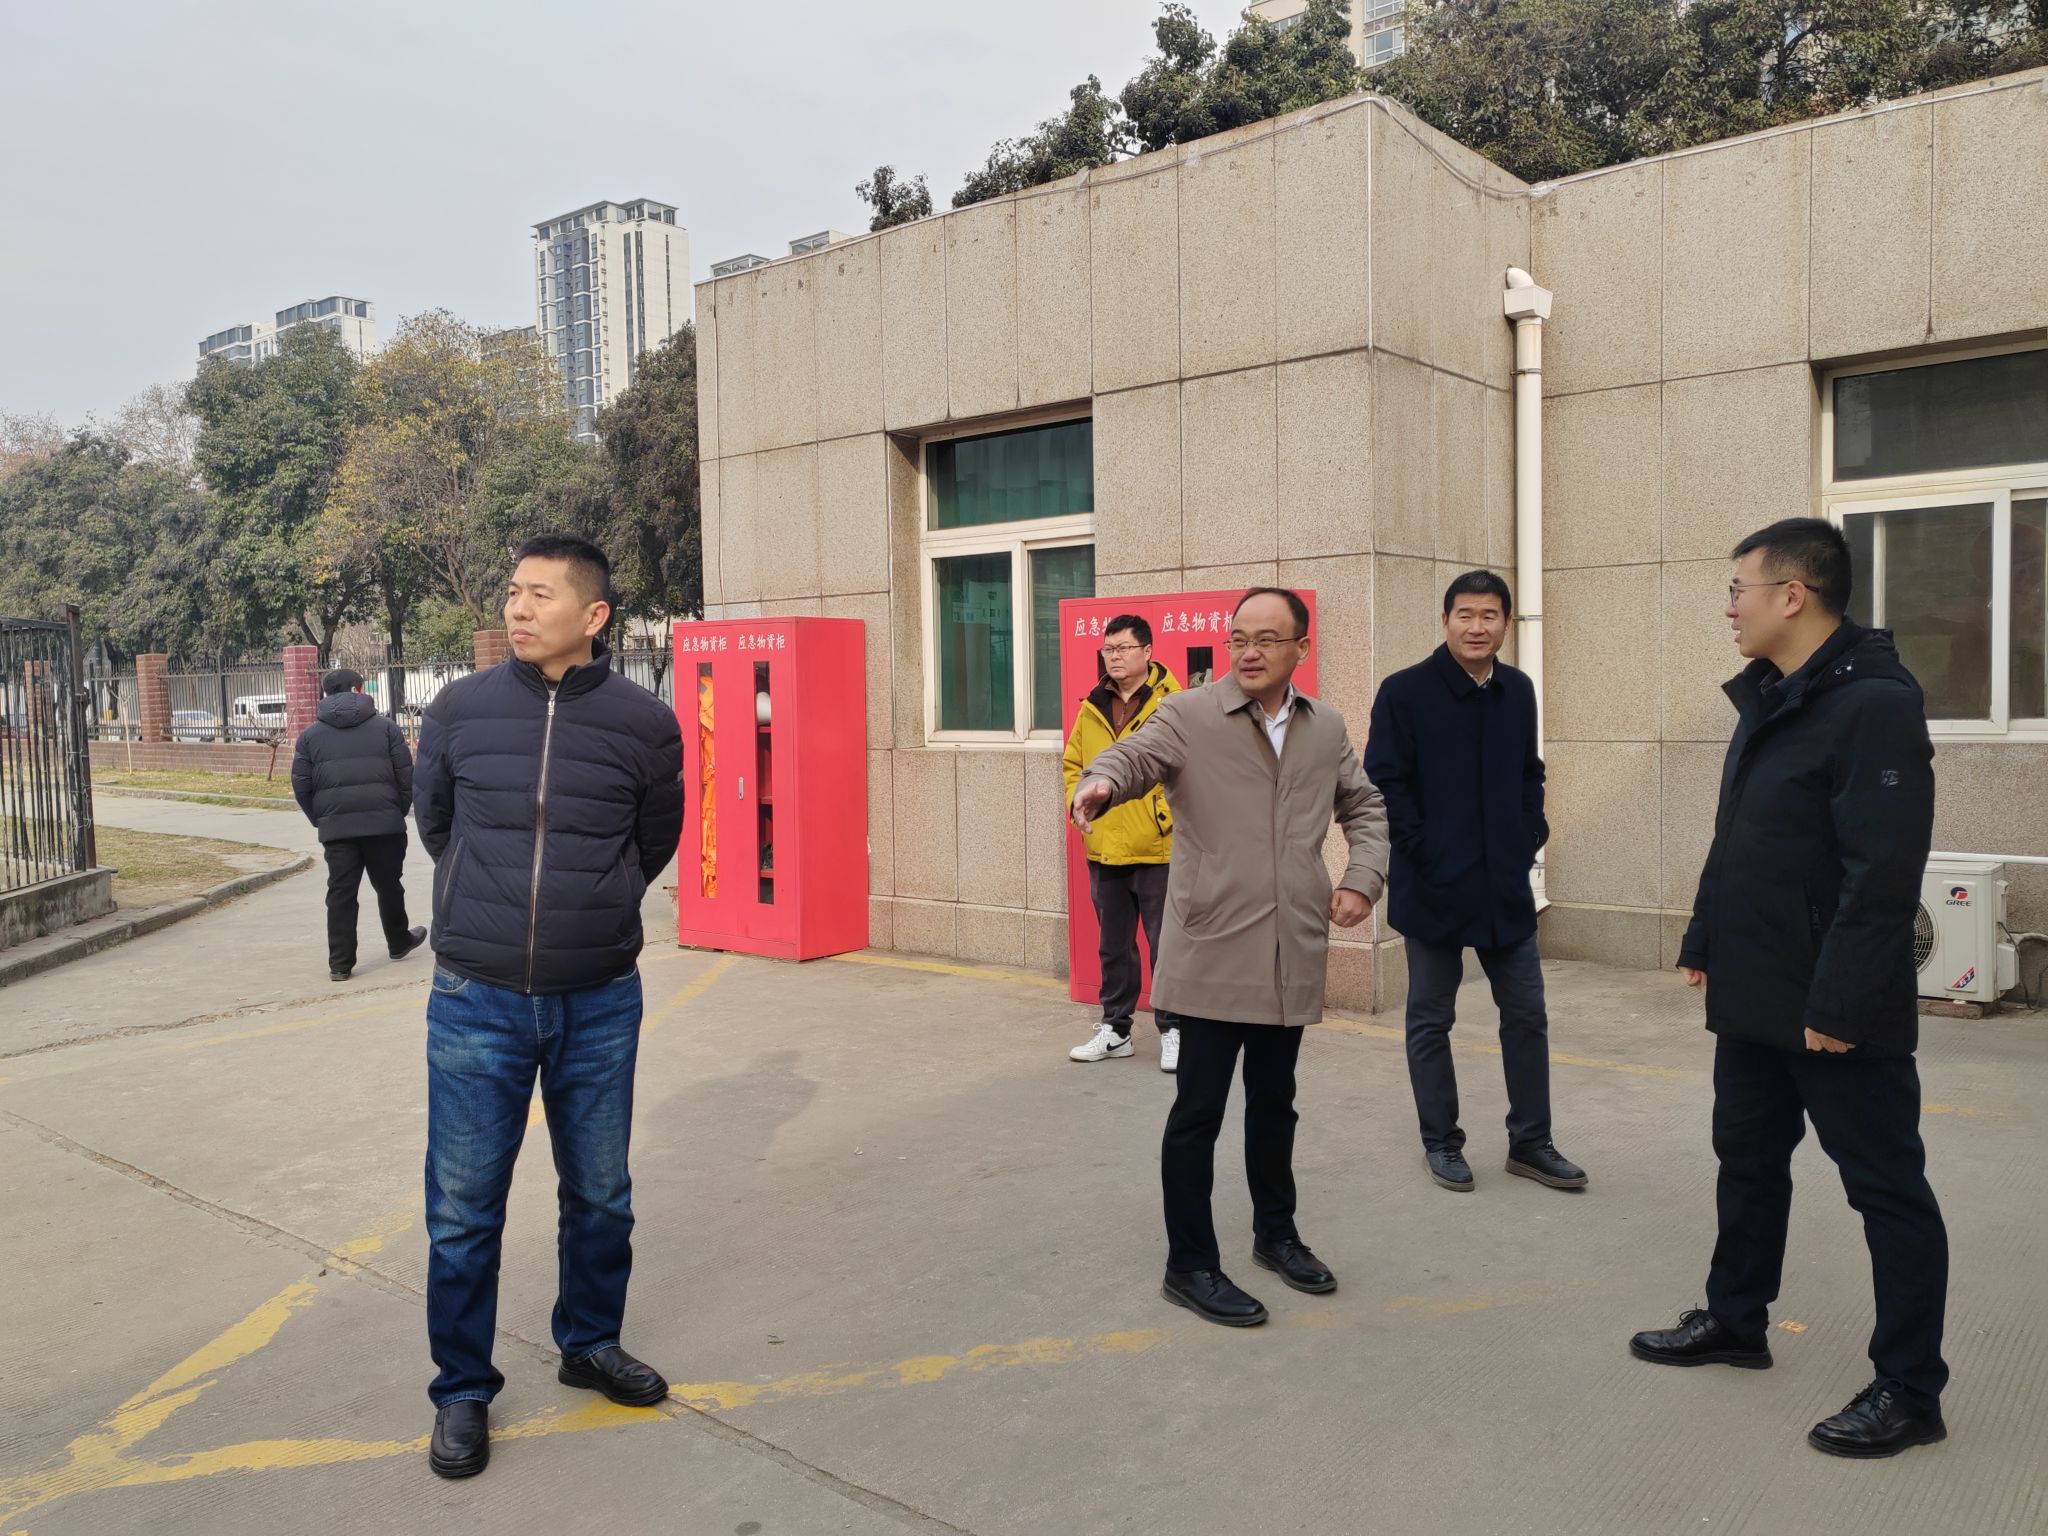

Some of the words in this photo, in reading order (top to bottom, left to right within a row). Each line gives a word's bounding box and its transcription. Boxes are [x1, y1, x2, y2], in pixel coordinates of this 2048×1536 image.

[682, 635, 727, 652] 应急物资柜
[738, 633, 785, 650] 应急物资柜
[1945, 899, 1972, 907] GREE
